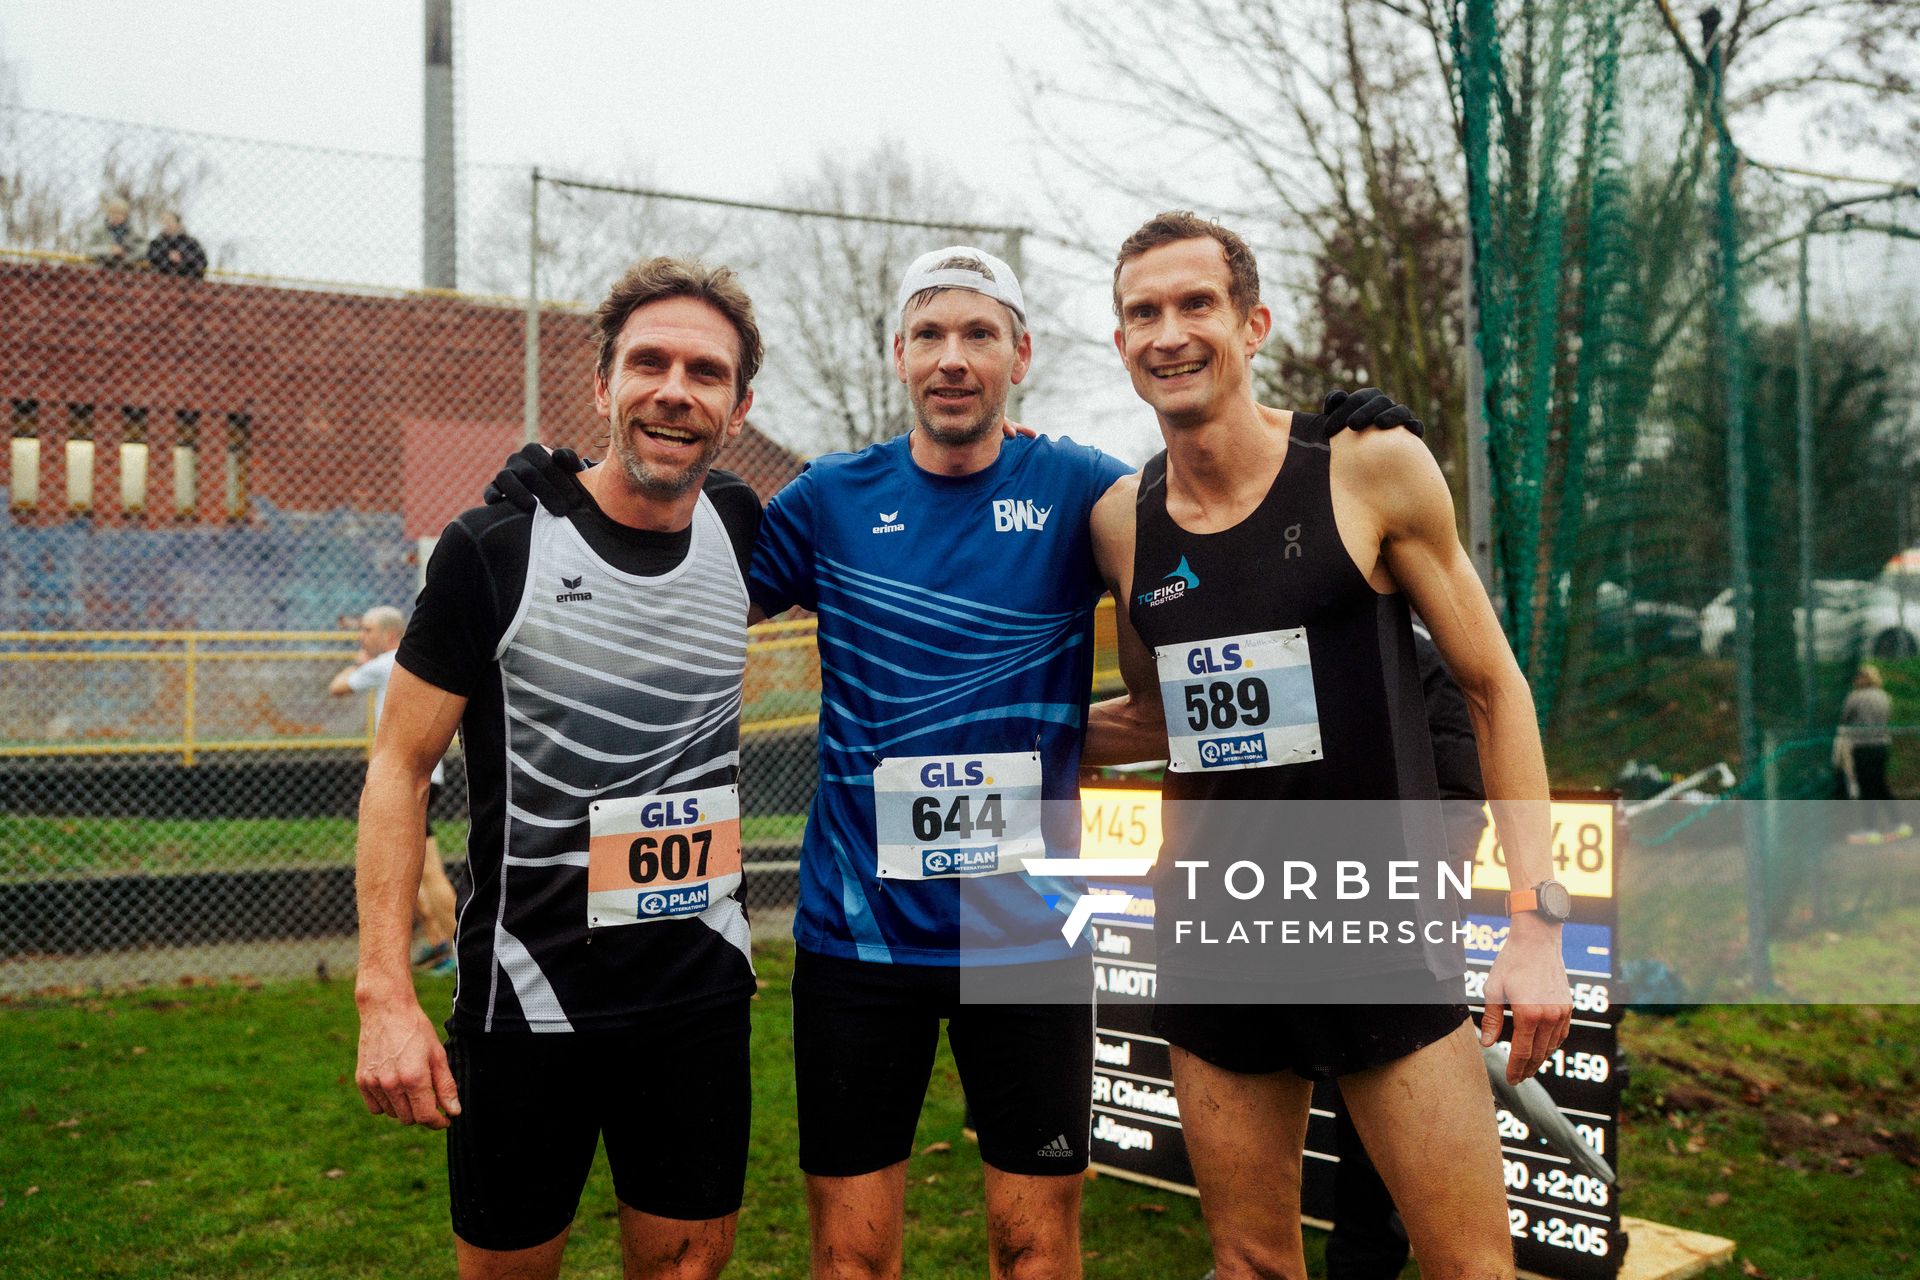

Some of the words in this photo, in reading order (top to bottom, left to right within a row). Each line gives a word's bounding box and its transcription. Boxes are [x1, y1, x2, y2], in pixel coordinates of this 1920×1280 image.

[872, 521, 905, 534] erima
[556, 590, 593, 603] erima
[1150, 591, 1184, 608] ROSTOCK
[1184, 677, 1271, 732] 589
[1221, 739, 1263, 756] PLAN
[1222, 753, 1264, 762] INTERNATIONAL
[912, 793, 1006, 842] 644
[628, 830, 713, 884] 607
[953, 851, 996, 865] PLAN
[669, 889, 707, 906] PLAN
[669, 902, 707, 913] INTERNATIONAL
[1037, 1149, 1074, 1158] adidas
[1532, 1169, 1609, 1207] +2:03
[1531, 1217, 1609, 1257] +2:05
